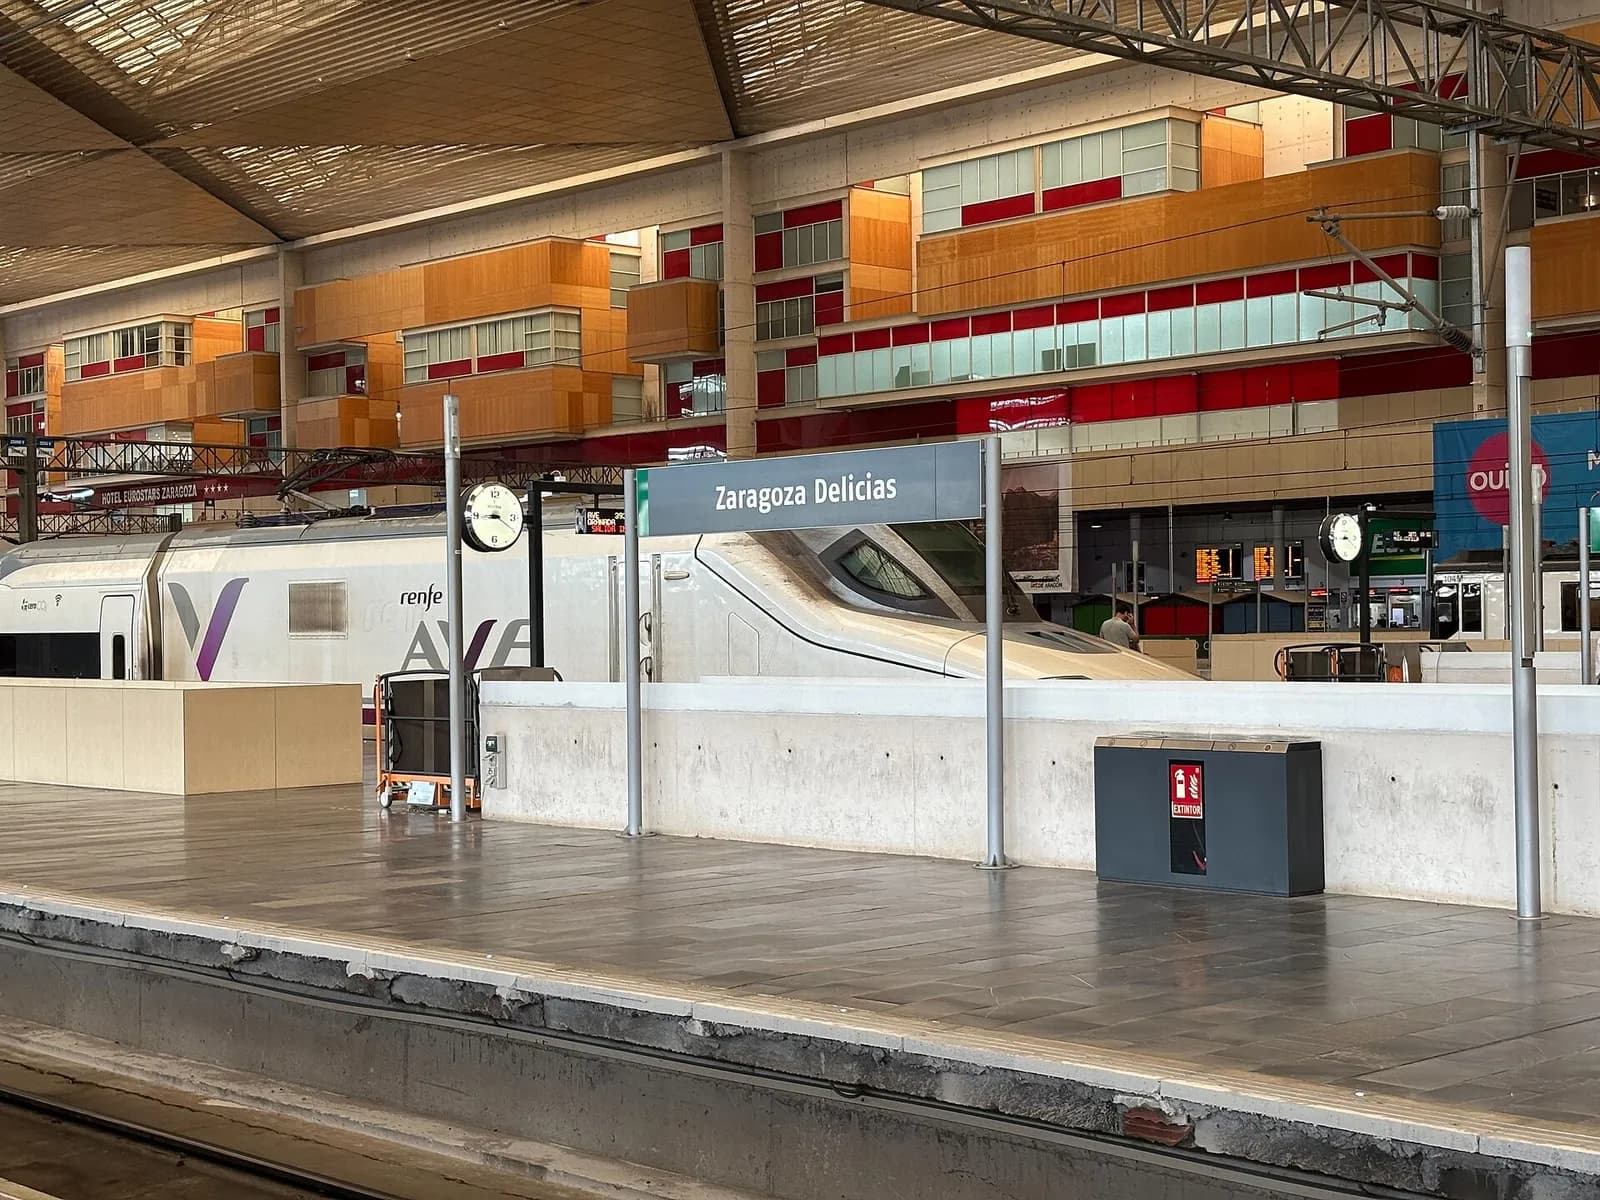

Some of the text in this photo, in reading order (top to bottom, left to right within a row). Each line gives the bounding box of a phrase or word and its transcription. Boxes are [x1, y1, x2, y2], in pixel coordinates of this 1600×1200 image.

[102, 484, 197, 505] HOTEL EUROSTARS ZARAGOZA
[491, 490, 500, 498] 12
[715, 472, 897, 514] Zaragoza Delicias
[473, 512, 480, 520] 9
[510, 514, 516, 522] 3
[491, 535, 498, 543] 6
[400, 583, 443, 612] renfe
[1173, 804, 1201, 815] EXTINTOR
